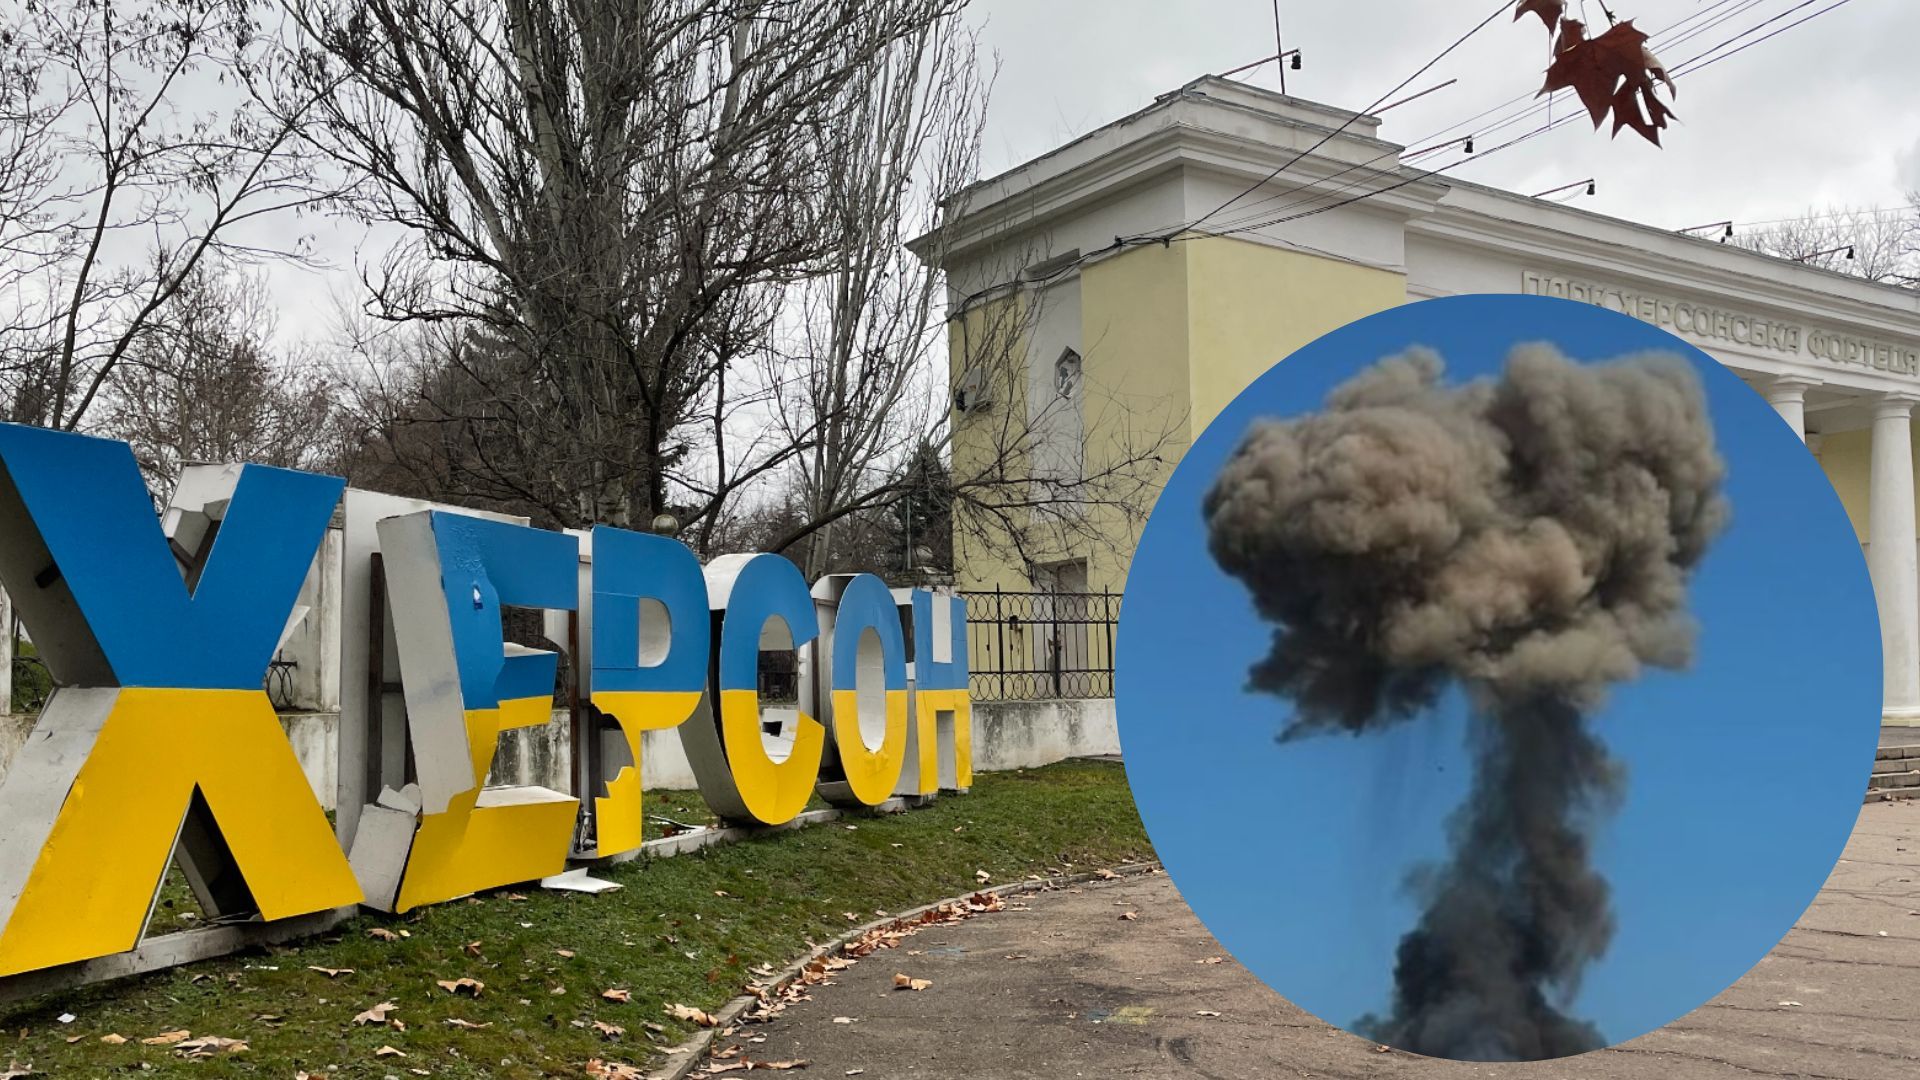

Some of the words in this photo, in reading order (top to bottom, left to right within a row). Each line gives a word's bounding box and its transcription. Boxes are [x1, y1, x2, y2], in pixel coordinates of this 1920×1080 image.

[1608, 289, 1801, 355] ХЕРСОНСЬКА
[1807, 329, 1919, 377] ФОРТЕЦЯ
[0, 422, 972, 976] ХЕРСОН
